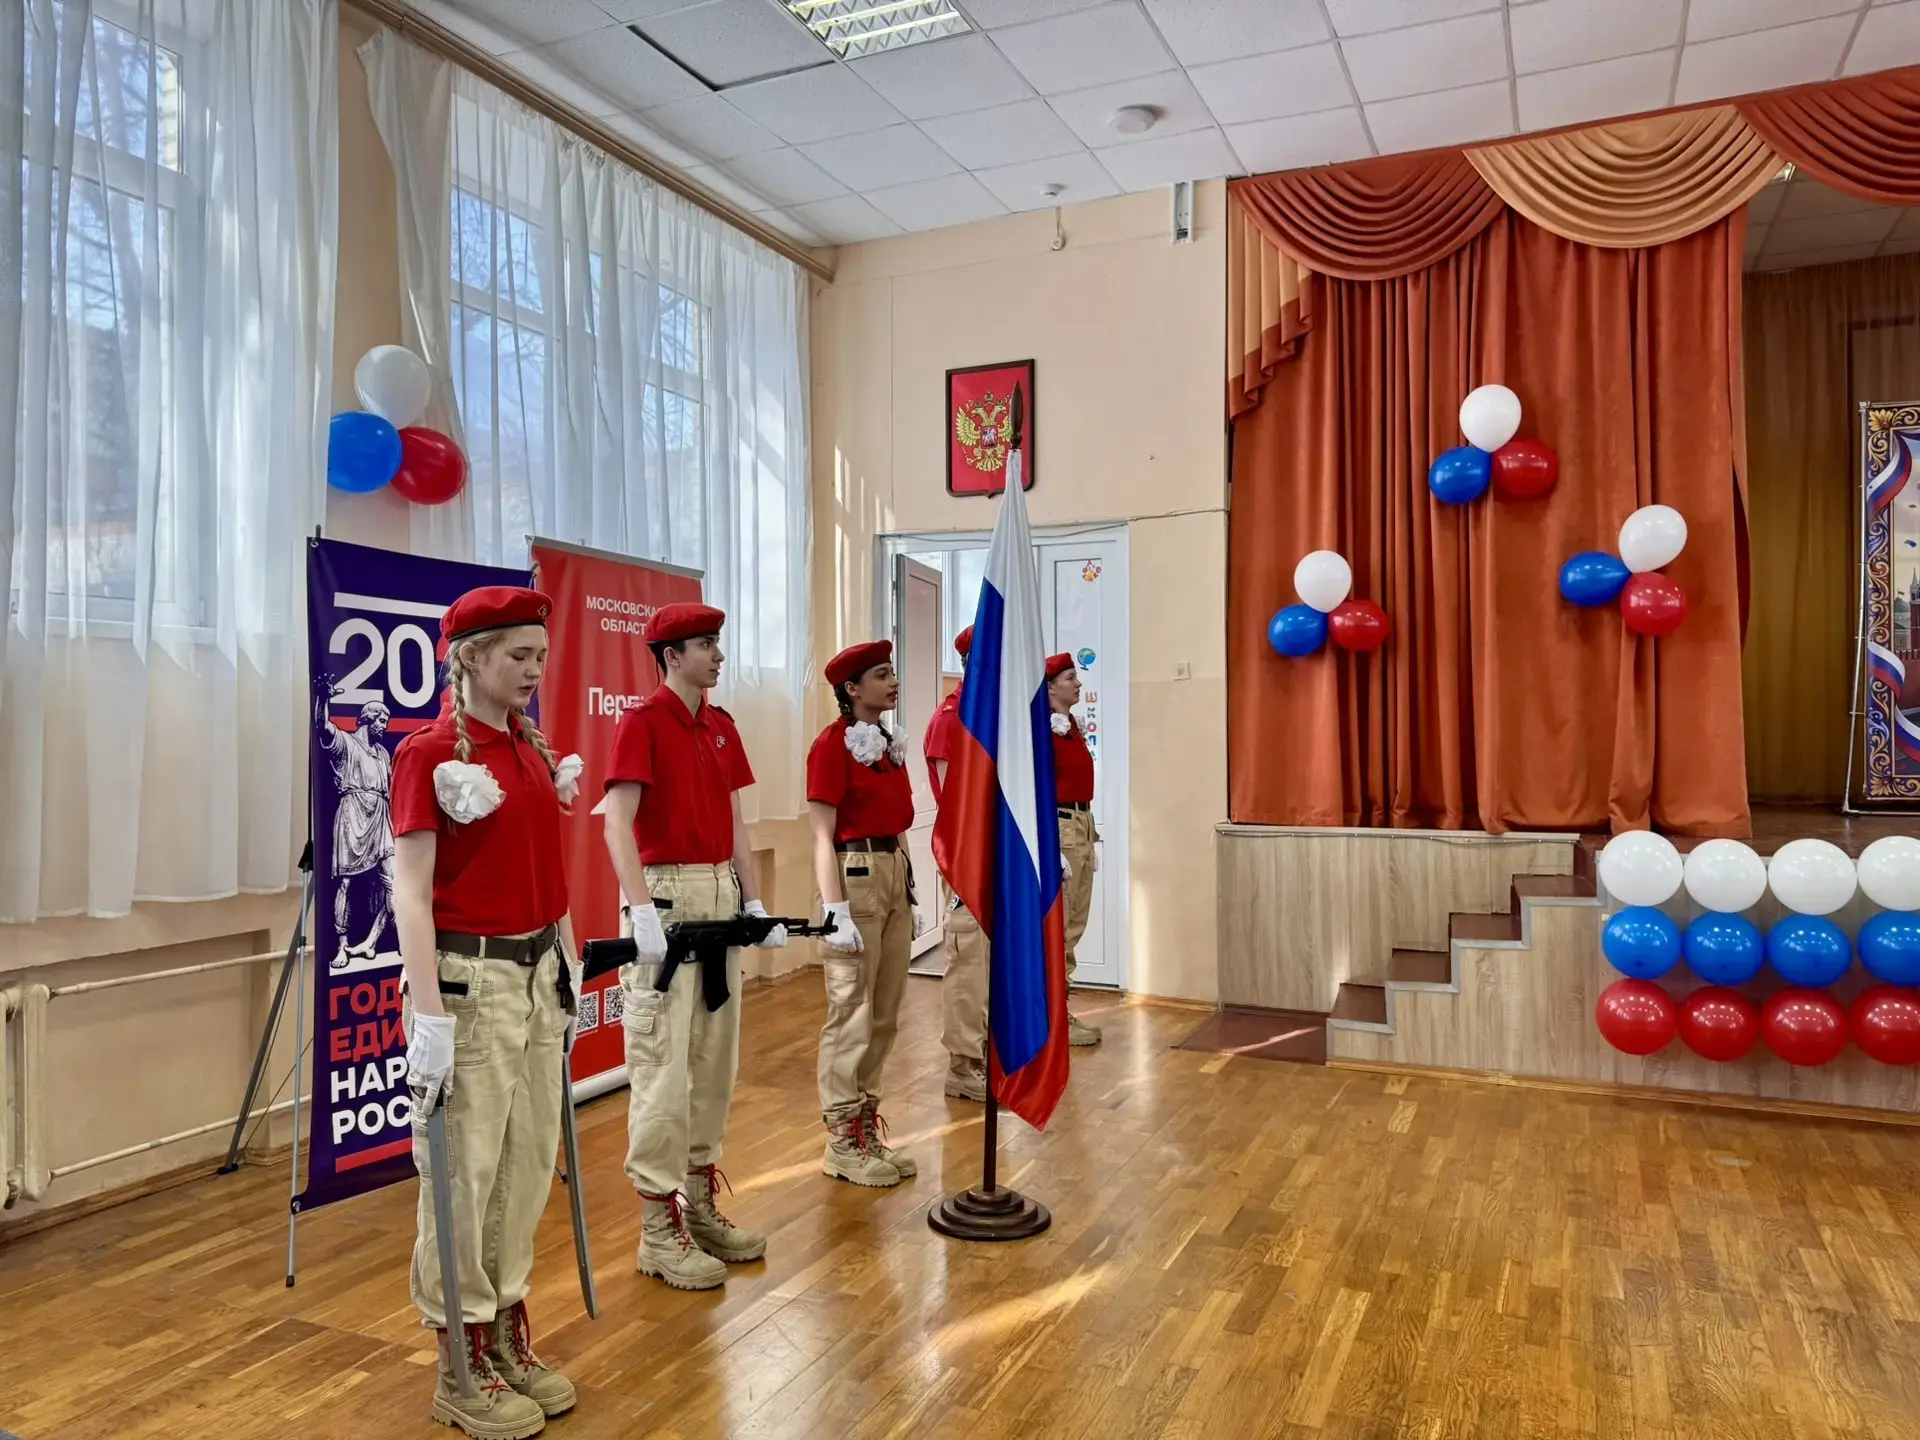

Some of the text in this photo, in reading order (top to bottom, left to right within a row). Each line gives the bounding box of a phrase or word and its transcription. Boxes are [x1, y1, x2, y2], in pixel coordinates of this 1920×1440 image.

[586, 595, 661, 617] МОСКОВСКА
[600, 617, 646, 635] ОБЛАСТ
[329, 617, 452, 709] 20
[588, 687, 644, 724] Пер
[1085, 691, 1097, 761] ШКОЛ
[329, 976, 403, 1021] ГОД
[330, 1016, 407, 1062] ЕДИ
[330, 1056, 409, 1104] НАР
[332, 1095, 413, 1145] РОС
